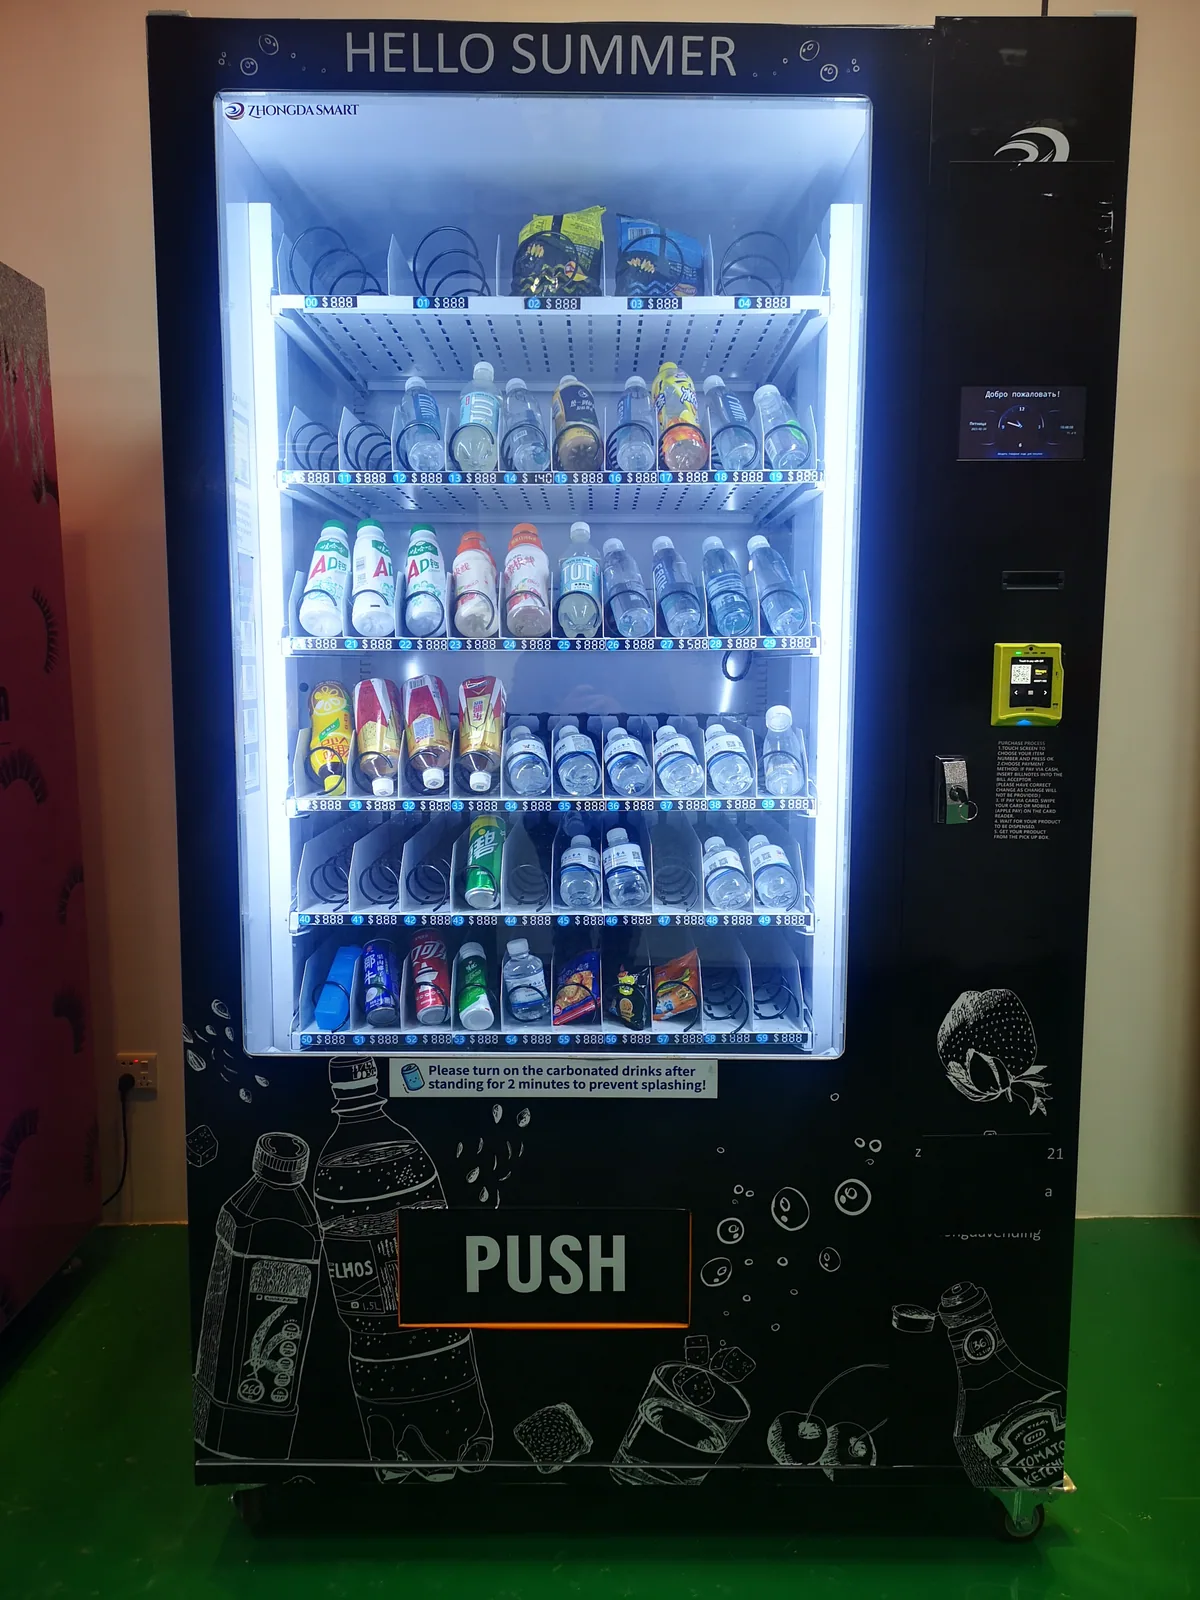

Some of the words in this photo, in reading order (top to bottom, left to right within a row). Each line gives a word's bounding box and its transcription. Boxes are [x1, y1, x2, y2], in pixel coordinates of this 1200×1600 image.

[345, 31, 494, 74] HELLO
[511, 32, 738, 77] SUMMER
[247, 104, 314, 118] ZHONGDA
[315, 104, 360, 117] SMART
[985, 390, 1008, 400] Добро
[1012, 390, 1060, 399] пожаловать!
[534, 473, 552, 483] 140
[562, 562, 593, 584] TUT
[429, 1064, 470, 1076] Please
[473, 1066, 500, 1076] turn
[504, 1067, 519, 1076] on
[522, 1064, 543, 1076] the
[546, 1065, 618, 1076] carbonated
[622, 1065, 662, 1077] drinks
[665, 1065, 696, 1077] after
[429, 1078, 483, 1092] standing
[486, 1078, 504, 1090] for
[508, 1079, 515, 1090] 2
[519, 1079, 569, 1090] minutes
[572, 1080, 585, 1090] to
[589, 1080, 638, 1092] prevent
[641, 1078, 706, 1092] splashing!
[1047, 1148, 1064, 1160] 21
[466, 1234, 626, 1294] PUSH
